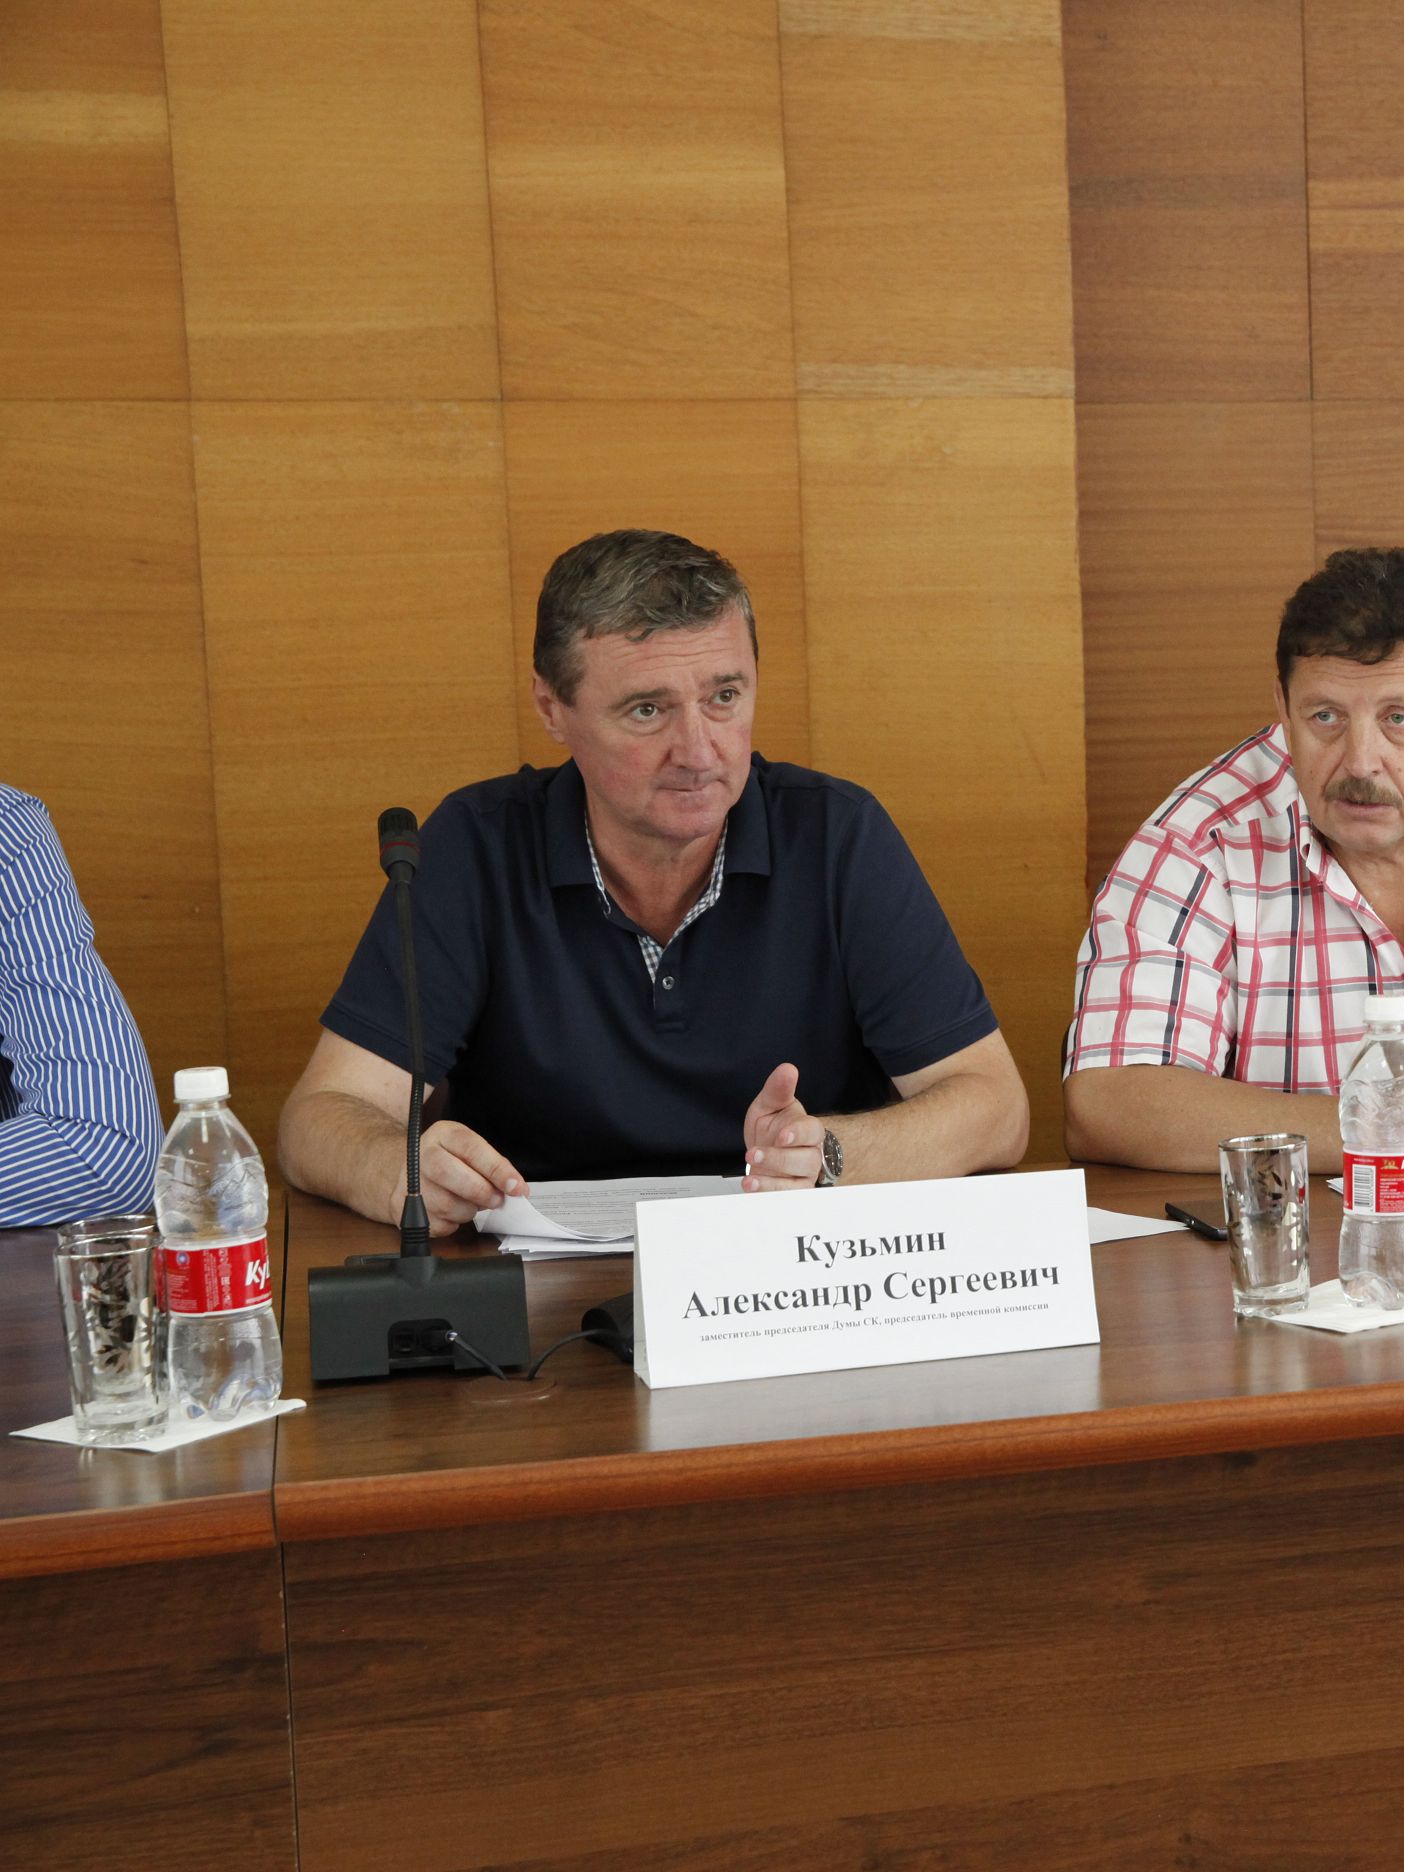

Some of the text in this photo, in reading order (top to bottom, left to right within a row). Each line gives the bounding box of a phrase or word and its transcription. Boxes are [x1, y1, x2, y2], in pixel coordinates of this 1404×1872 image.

[795, 1231, 946, 1268] Кузьмин
[683, 1266, 1060, 1319] Александр Сергеевич
[701, 1303, 1049, 1342] заместитель председателя Думы СК, председатель временной комиссии
